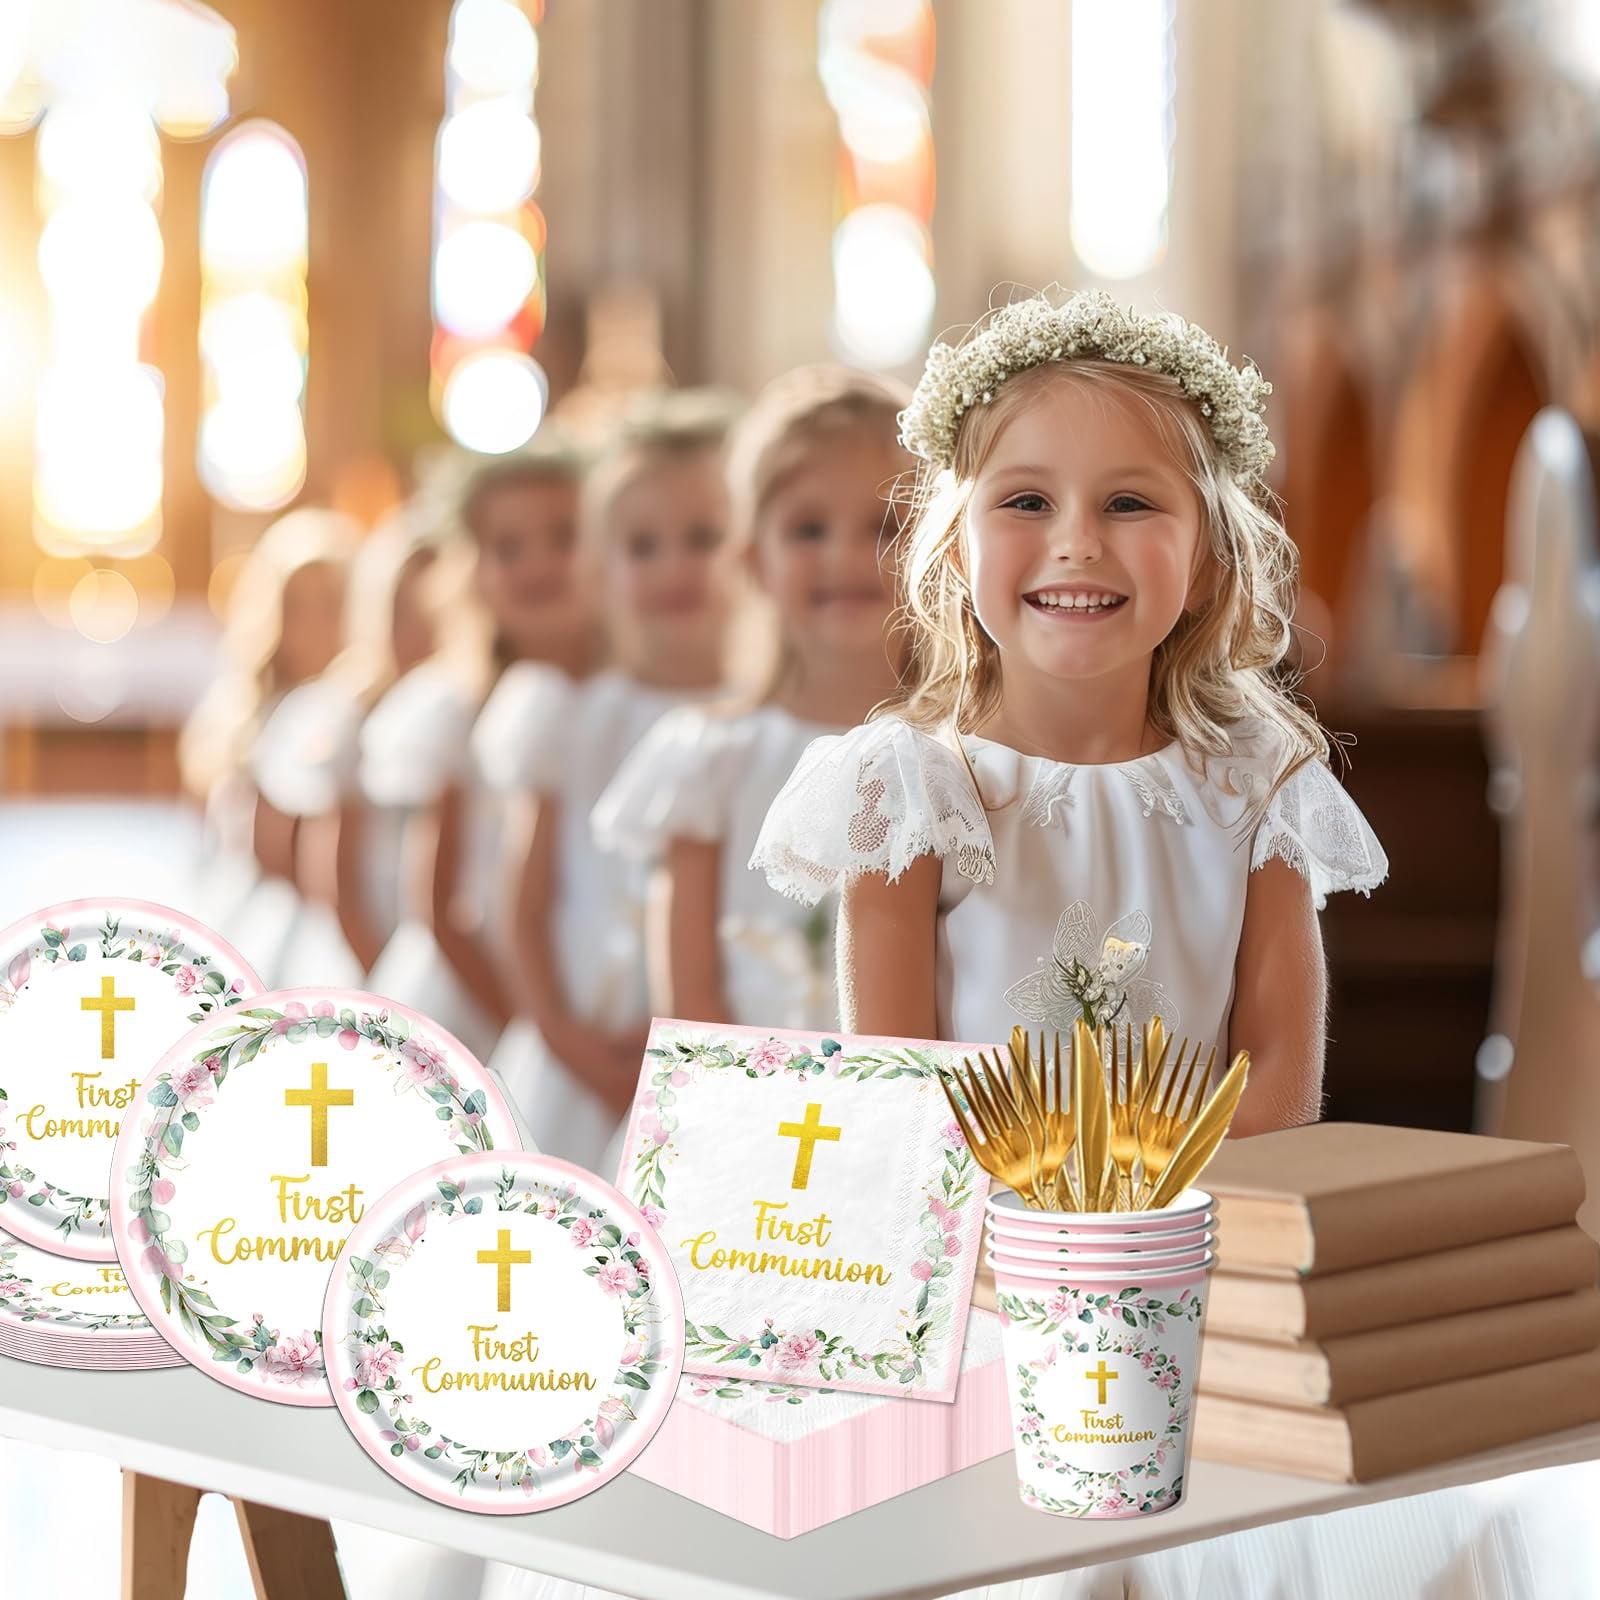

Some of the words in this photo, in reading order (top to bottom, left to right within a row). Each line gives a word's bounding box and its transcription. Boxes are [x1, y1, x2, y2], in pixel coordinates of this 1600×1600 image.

[72, 1072, 141, 1109] First
[270, 1174, 365, 1224] First
[752, 1200, 832, 1247] First
[680, 1231, 892, 1286] Communion
[467, 1324, 539, 1362] First
[411, 1357, 597, 1393] Communion
[1048, 1424, 1156, 1443] Communion
[1080, 1409, 1124, 1429] First
